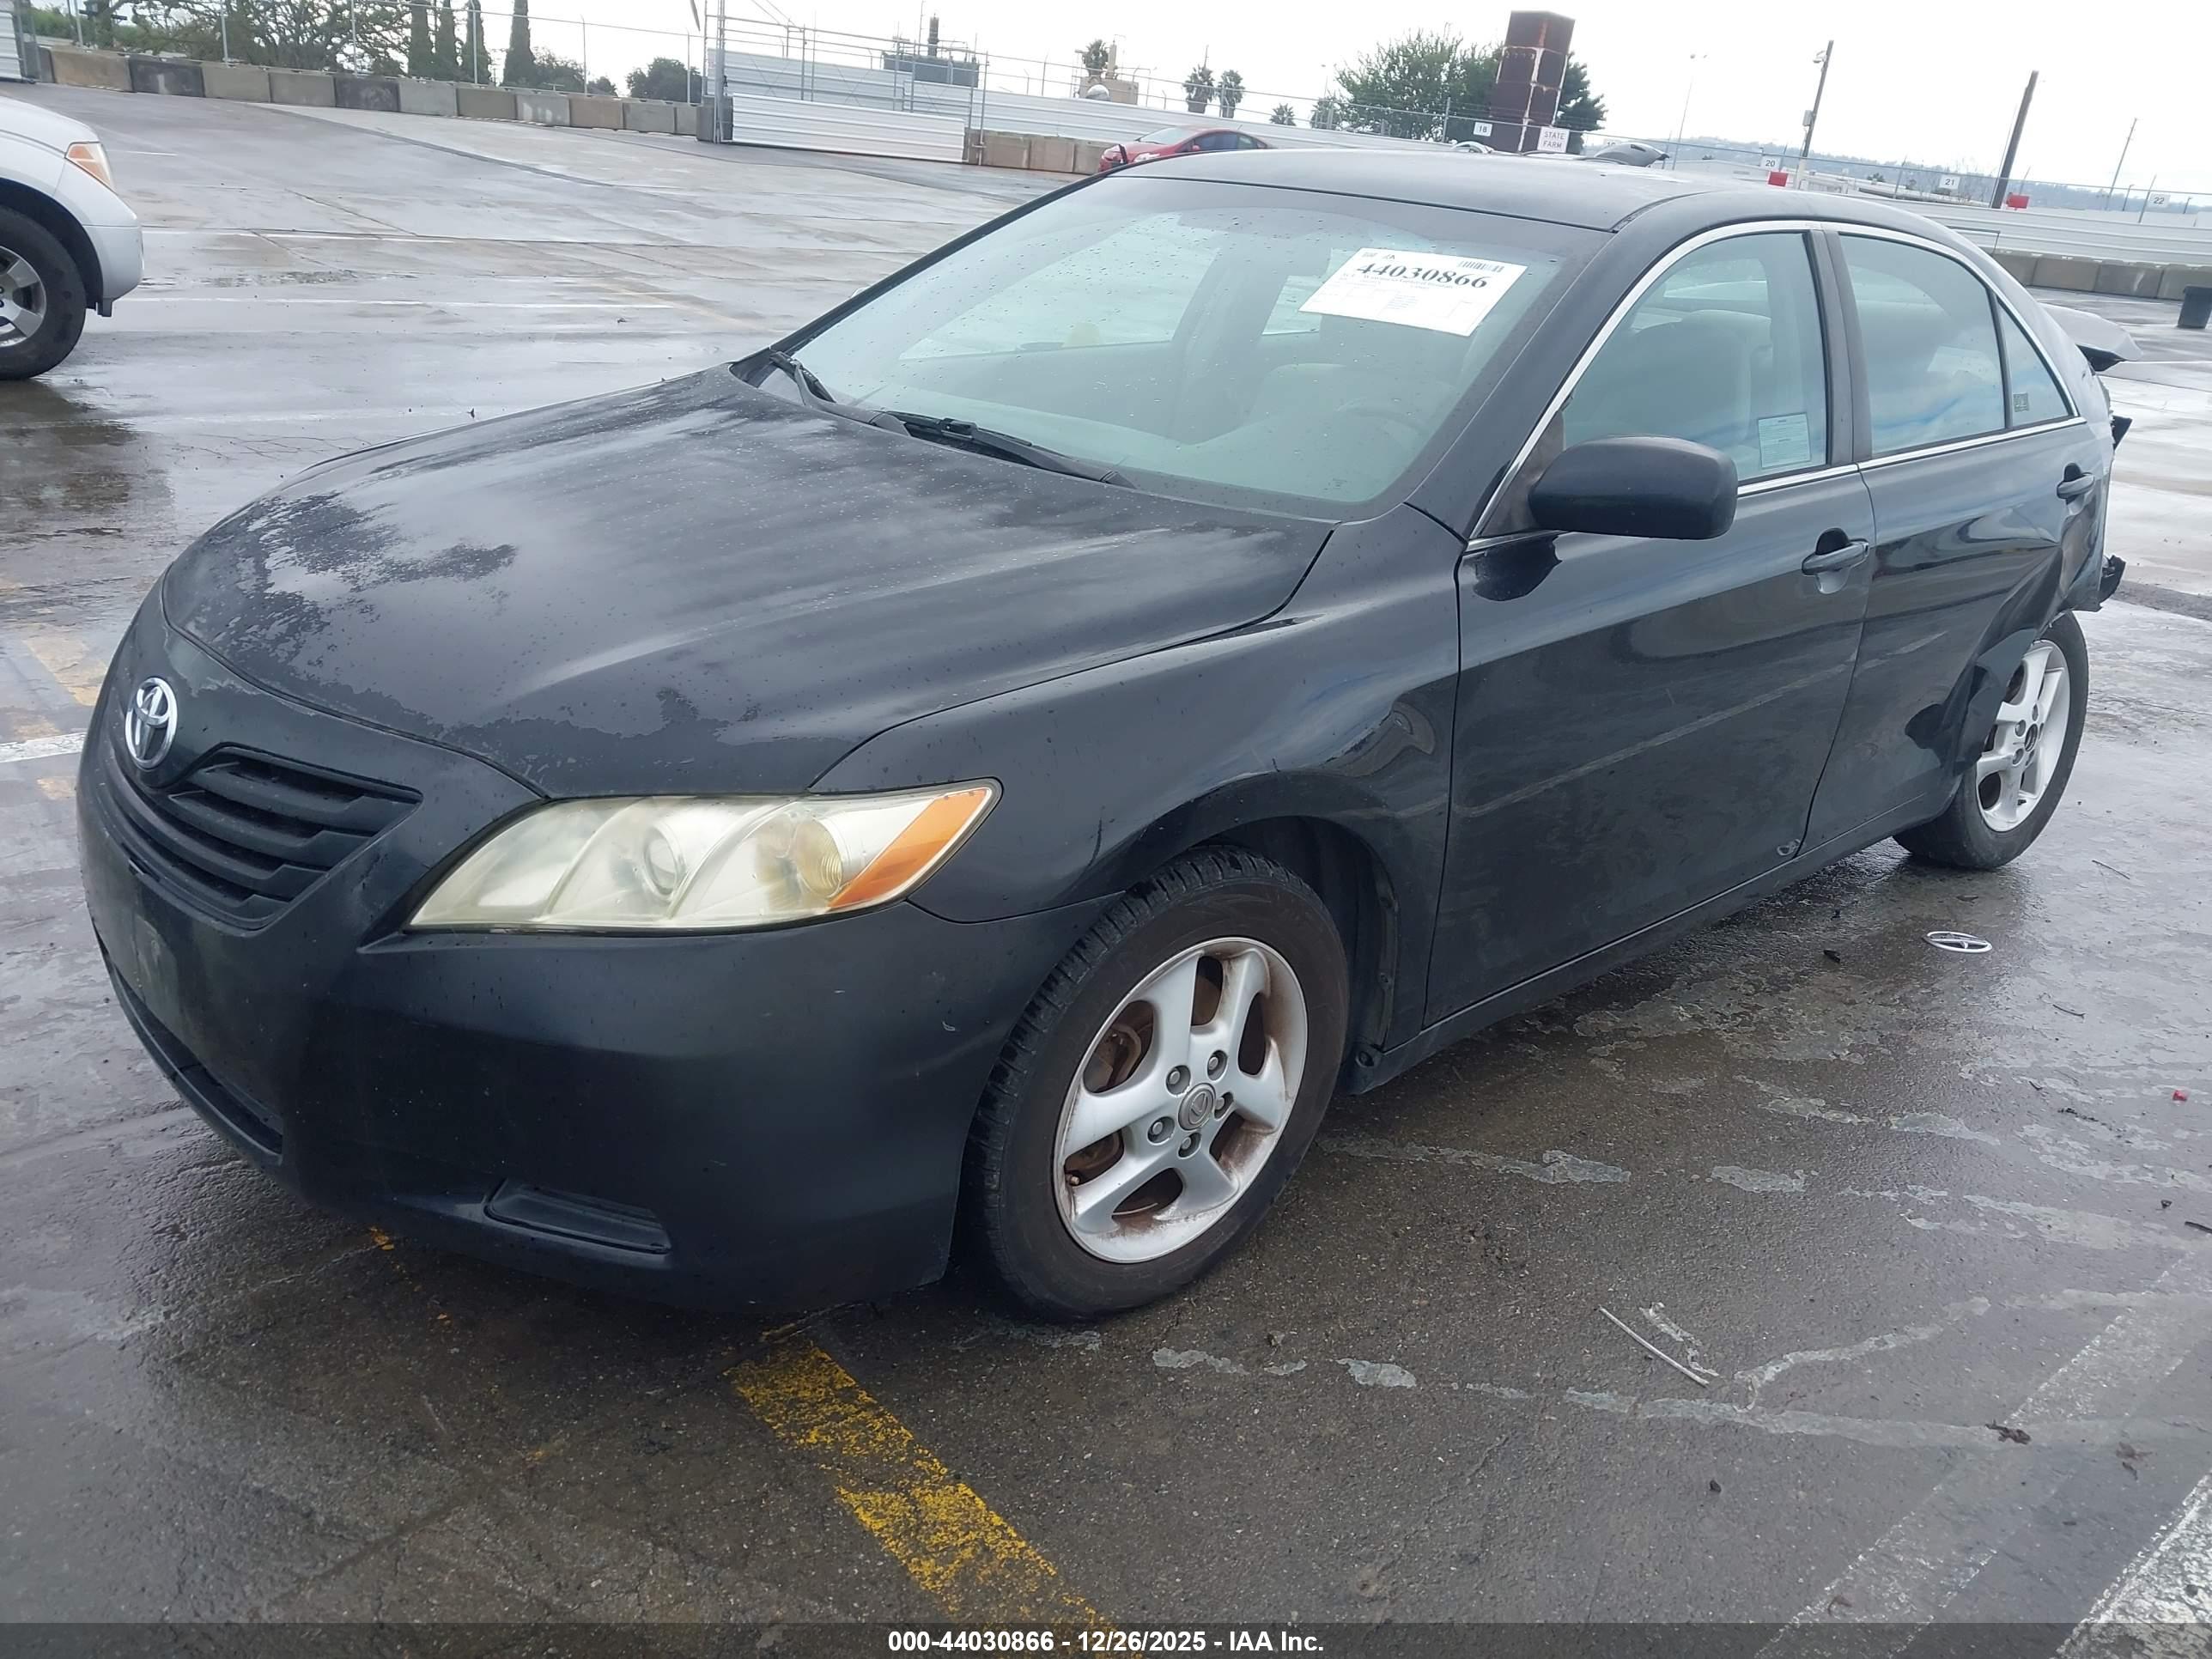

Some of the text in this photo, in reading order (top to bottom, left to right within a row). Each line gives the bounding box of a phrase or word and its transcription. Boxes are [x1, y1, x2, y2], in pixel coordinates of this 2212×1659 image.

[1479, 125, 1487, 133] 18
[1544, 131, 1566, 140] STATE
[1356, 263, 1491, 289] 44030866
